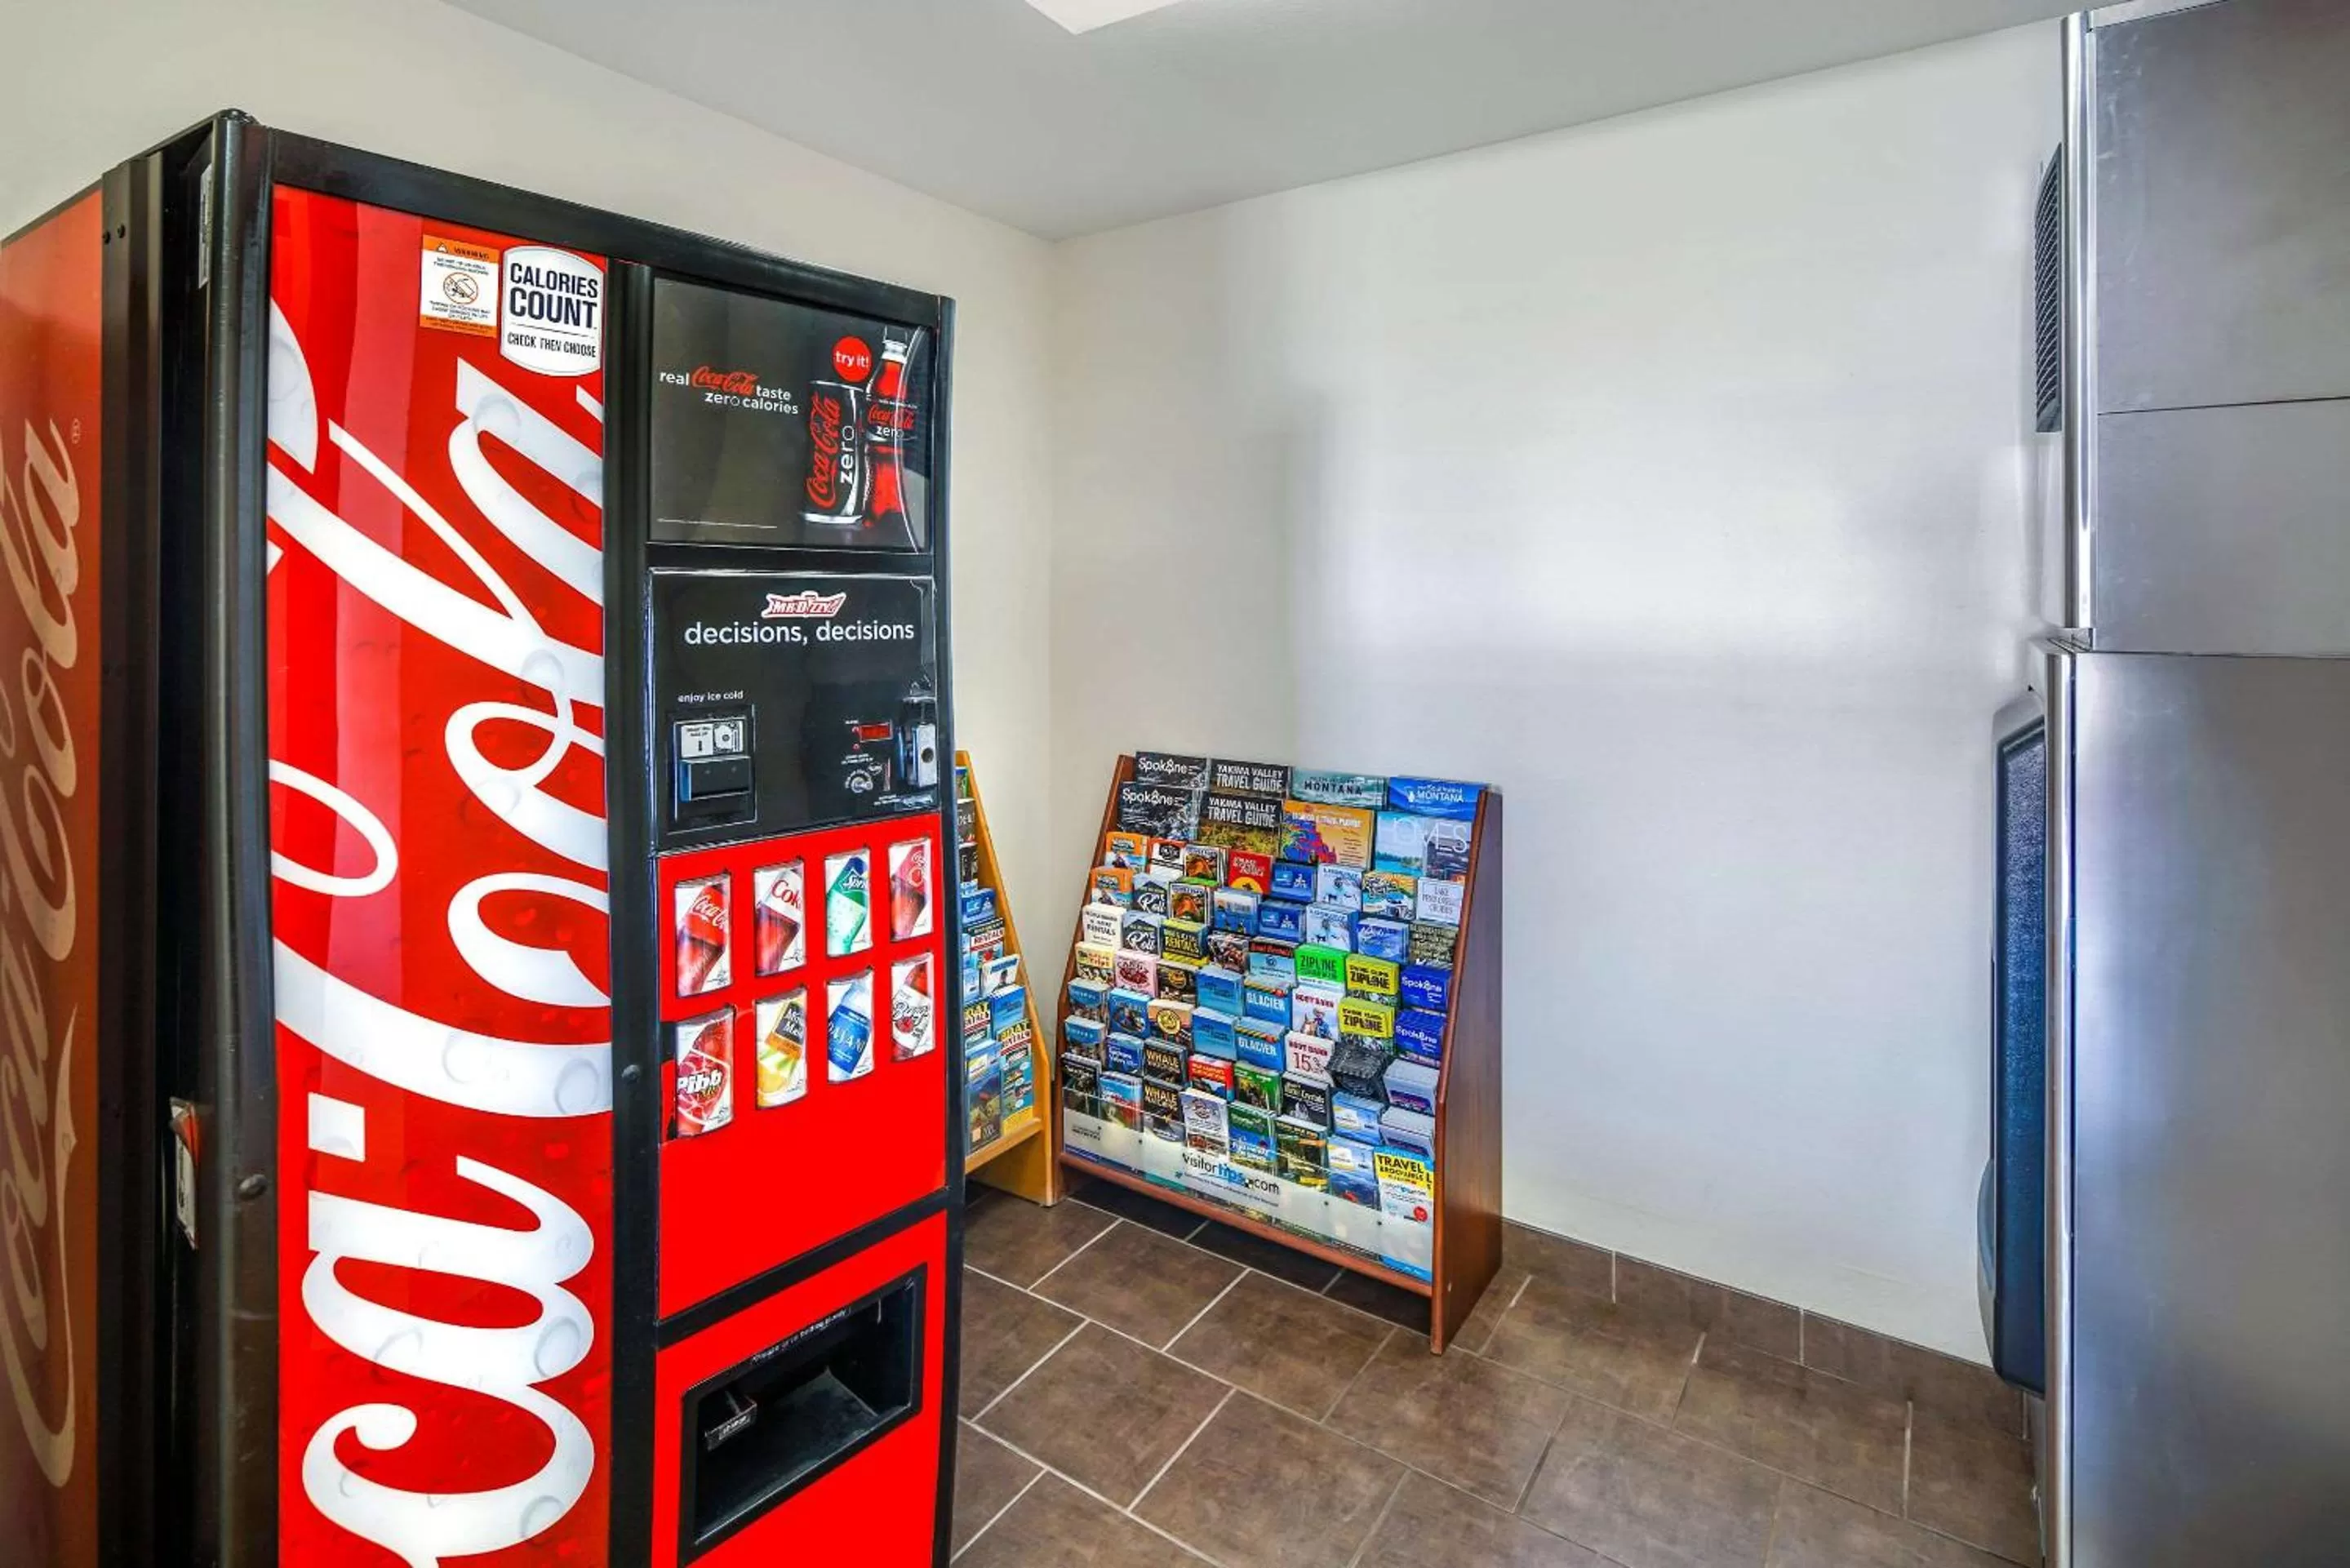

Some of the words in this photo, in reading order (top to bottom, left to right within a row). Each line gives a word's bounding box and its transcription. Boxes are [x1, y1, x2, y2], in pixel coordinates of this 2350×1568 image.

[510, 263, 598, 299] CALORIES
[509, 287, 597, 328] COUNT
[507, 332, 536, 349] CHECK
[540, 337, 561, 352] THEN
[563, 341, 597, 358] CHOOSE
[835, 351, 855, 367] try
[856, 354, 870, 368] it!
[660, 371, 690, 386] real
[756, 384, 792, 401] taste
[704, 392, 740, 407] zero
[742, 398, 799, 415] calories
[840, 424, 855, 485] zero
[684, 621, 808, 646] decisions,
[815, 620, 915, 642] decisions
[677, 694, 704, 704] enjoy
[707, 691, 722, 700] ice
[723, 691, 744, 700] cold
[1216, 764, 1250, 775] YAKIMA
[1251, 767, 1284, 778] VALLEY
[1216, 774, 1251, 789] TRAVEL
[1252, 778, 1282, 793] GUIDE
[1304, 780, 1363, 795] MONTANA
[1208, 797, 1242, 809] YAKIMA
[1244, 801, 1277, 813] VALLEY
[1416, 790, 1464, 803] MONTANA
[1207, 806, 1242, 824] TRAVEL
[1245, 811, 1276, 828] GUIDE
[1351, 971, 1390, 989] ZIPLINE
[1246, 993, 1286, 1011] GLACIER
[1344, 1015, 1384, 1033] ZIPLINE
[1237, 1037, 1277, 1056] GLACIER
[1145, 1049, 1179, 1068] WHALE
[1144, 1085, 1178, 1103] WHALE
[1378, 1155, 1424, 1174] TRAVEL
